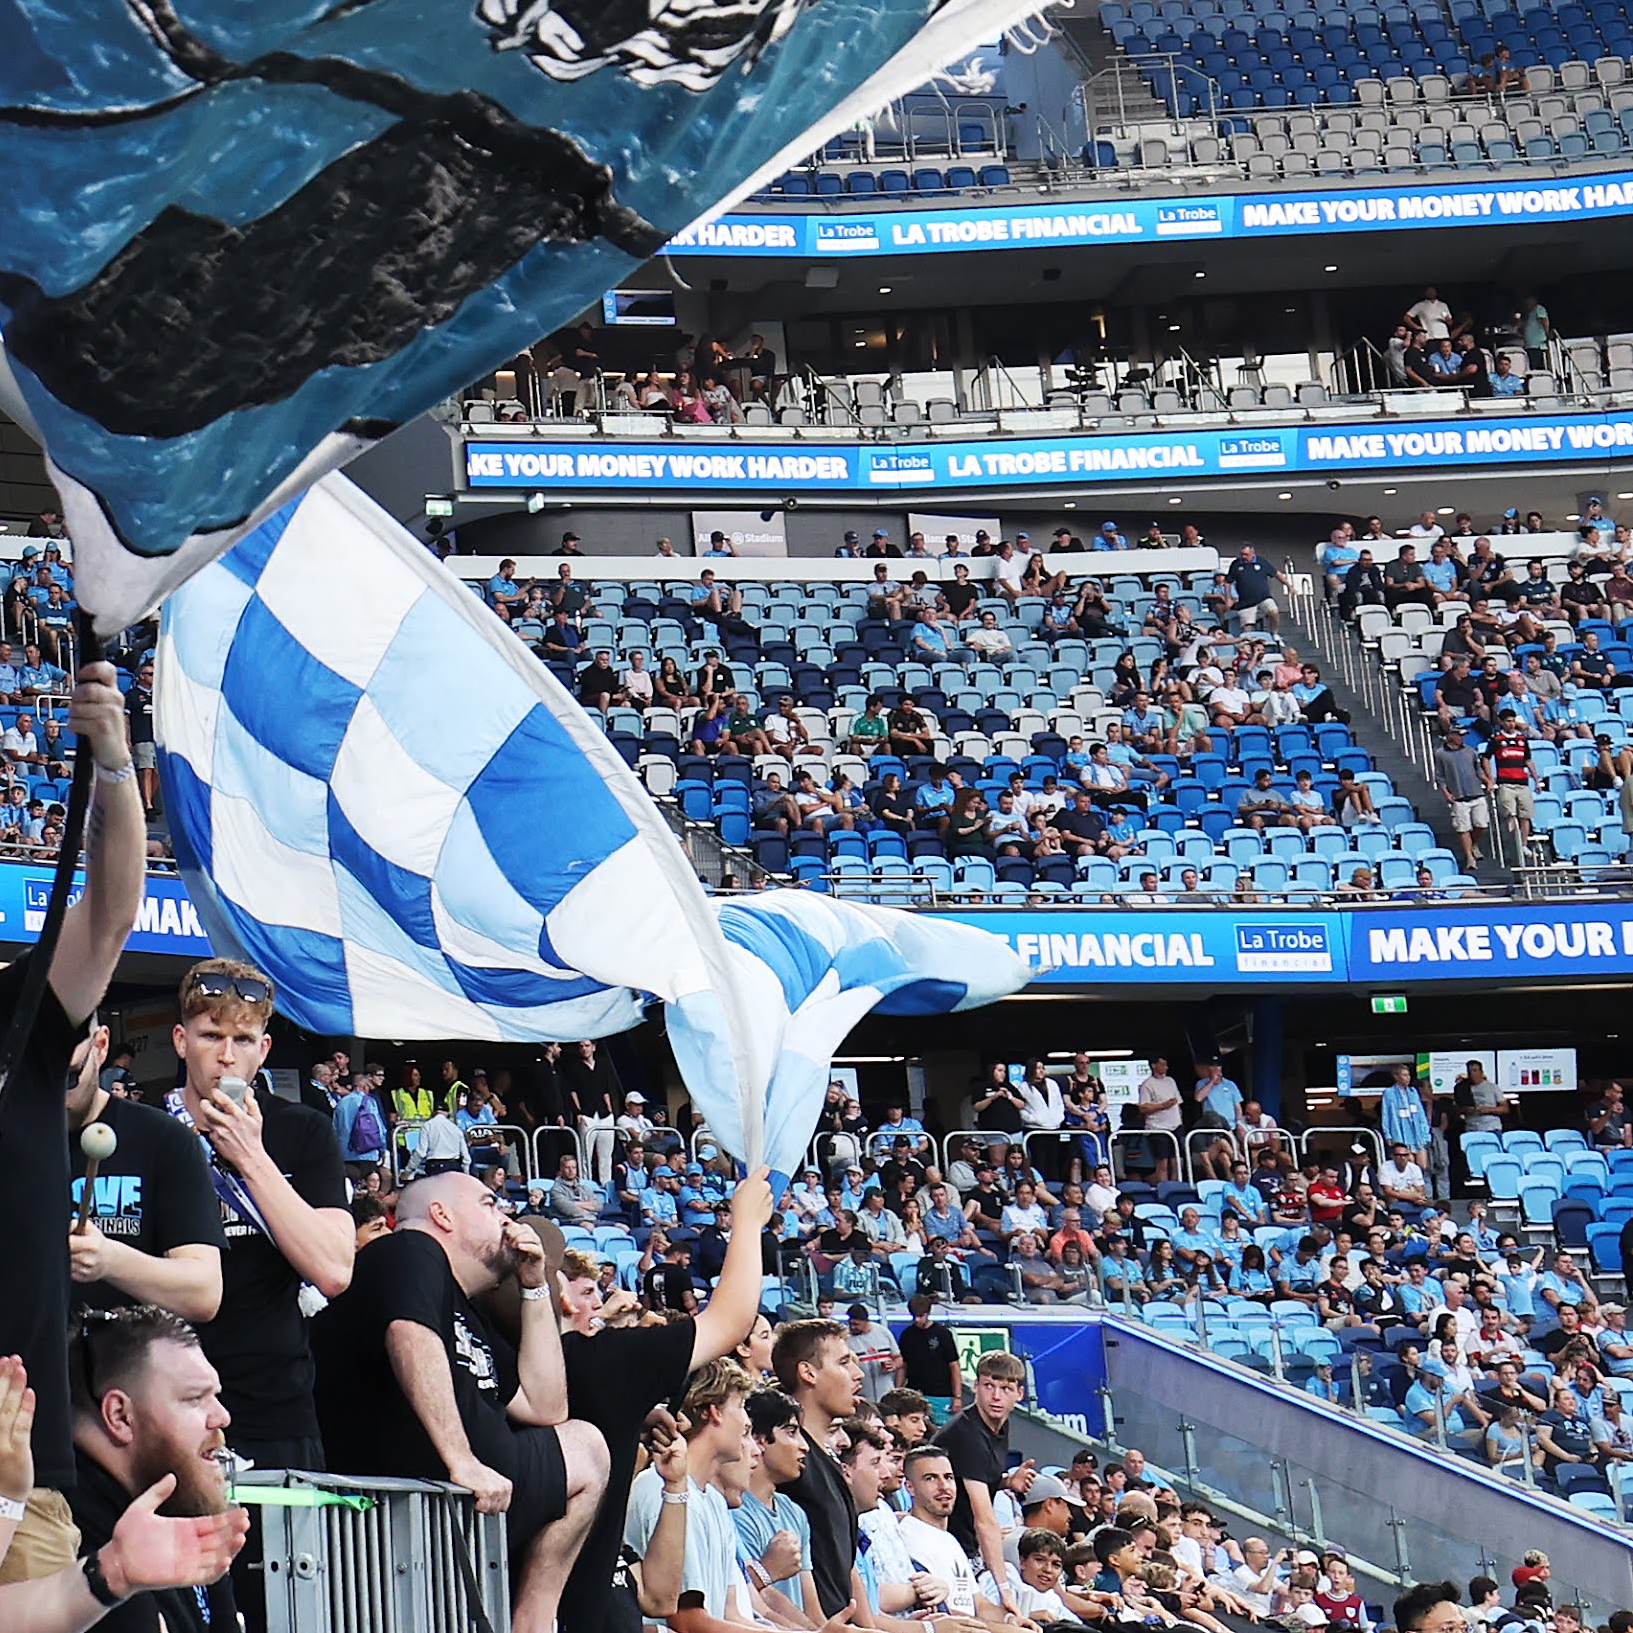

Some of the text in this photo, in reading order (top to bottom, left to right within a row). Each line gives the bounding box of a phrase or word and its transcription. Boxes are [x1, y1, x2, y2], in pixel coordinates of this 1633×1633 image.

[1158, 206, 1217, 222] La Trobe
[1243, 201, 1321, 227] MAKE
[1321, 197, 1397, 224] YOUR
[1397, 192, 1495, 221] MONEY
[1494, 185, 1582, 215] WORK
[697, 223, 797, 248] HARDER
[818, 223, 874, 238] La Trobe
[892, 223, 927, 246] LA
[926, 219, 1009, 244] TROBE
[1010, 212, 1143, 241] FINANCIAL
[1220, 438, 1281, 454] La Trobe
[1307, 433, 1386, 460] MAKE
[1386, 429, 1465, 457] YOUR
[1466, 425, 1565, 454] MONEY
[503, 453, 575, 478] YOUR
[577, 454, 668, 478] MONEY
[668, 454, 747, 480] WORK
[747, 456, 849, 480] HARDER
[871, 455, 930, 470] La Trobe
[948, 453, 982, 478] LA
[982, 450, 1066, 476] TROBE
[1067, 444, 1205, 471] FINANCIAL
[744, 532, 784, 544] Stadium
[27, 885, 48, 907] La
[132, 896, 208, 938] MAK
[1017, 933, 1215, 968] FINANCIAL
[1239, 929, 1324, 950] La Trobe
[1369, 925, 1493, 964] MAKE
[1493, 921, 1617, 960] YOUR
[71, 1175, 143, 1219] OVE
